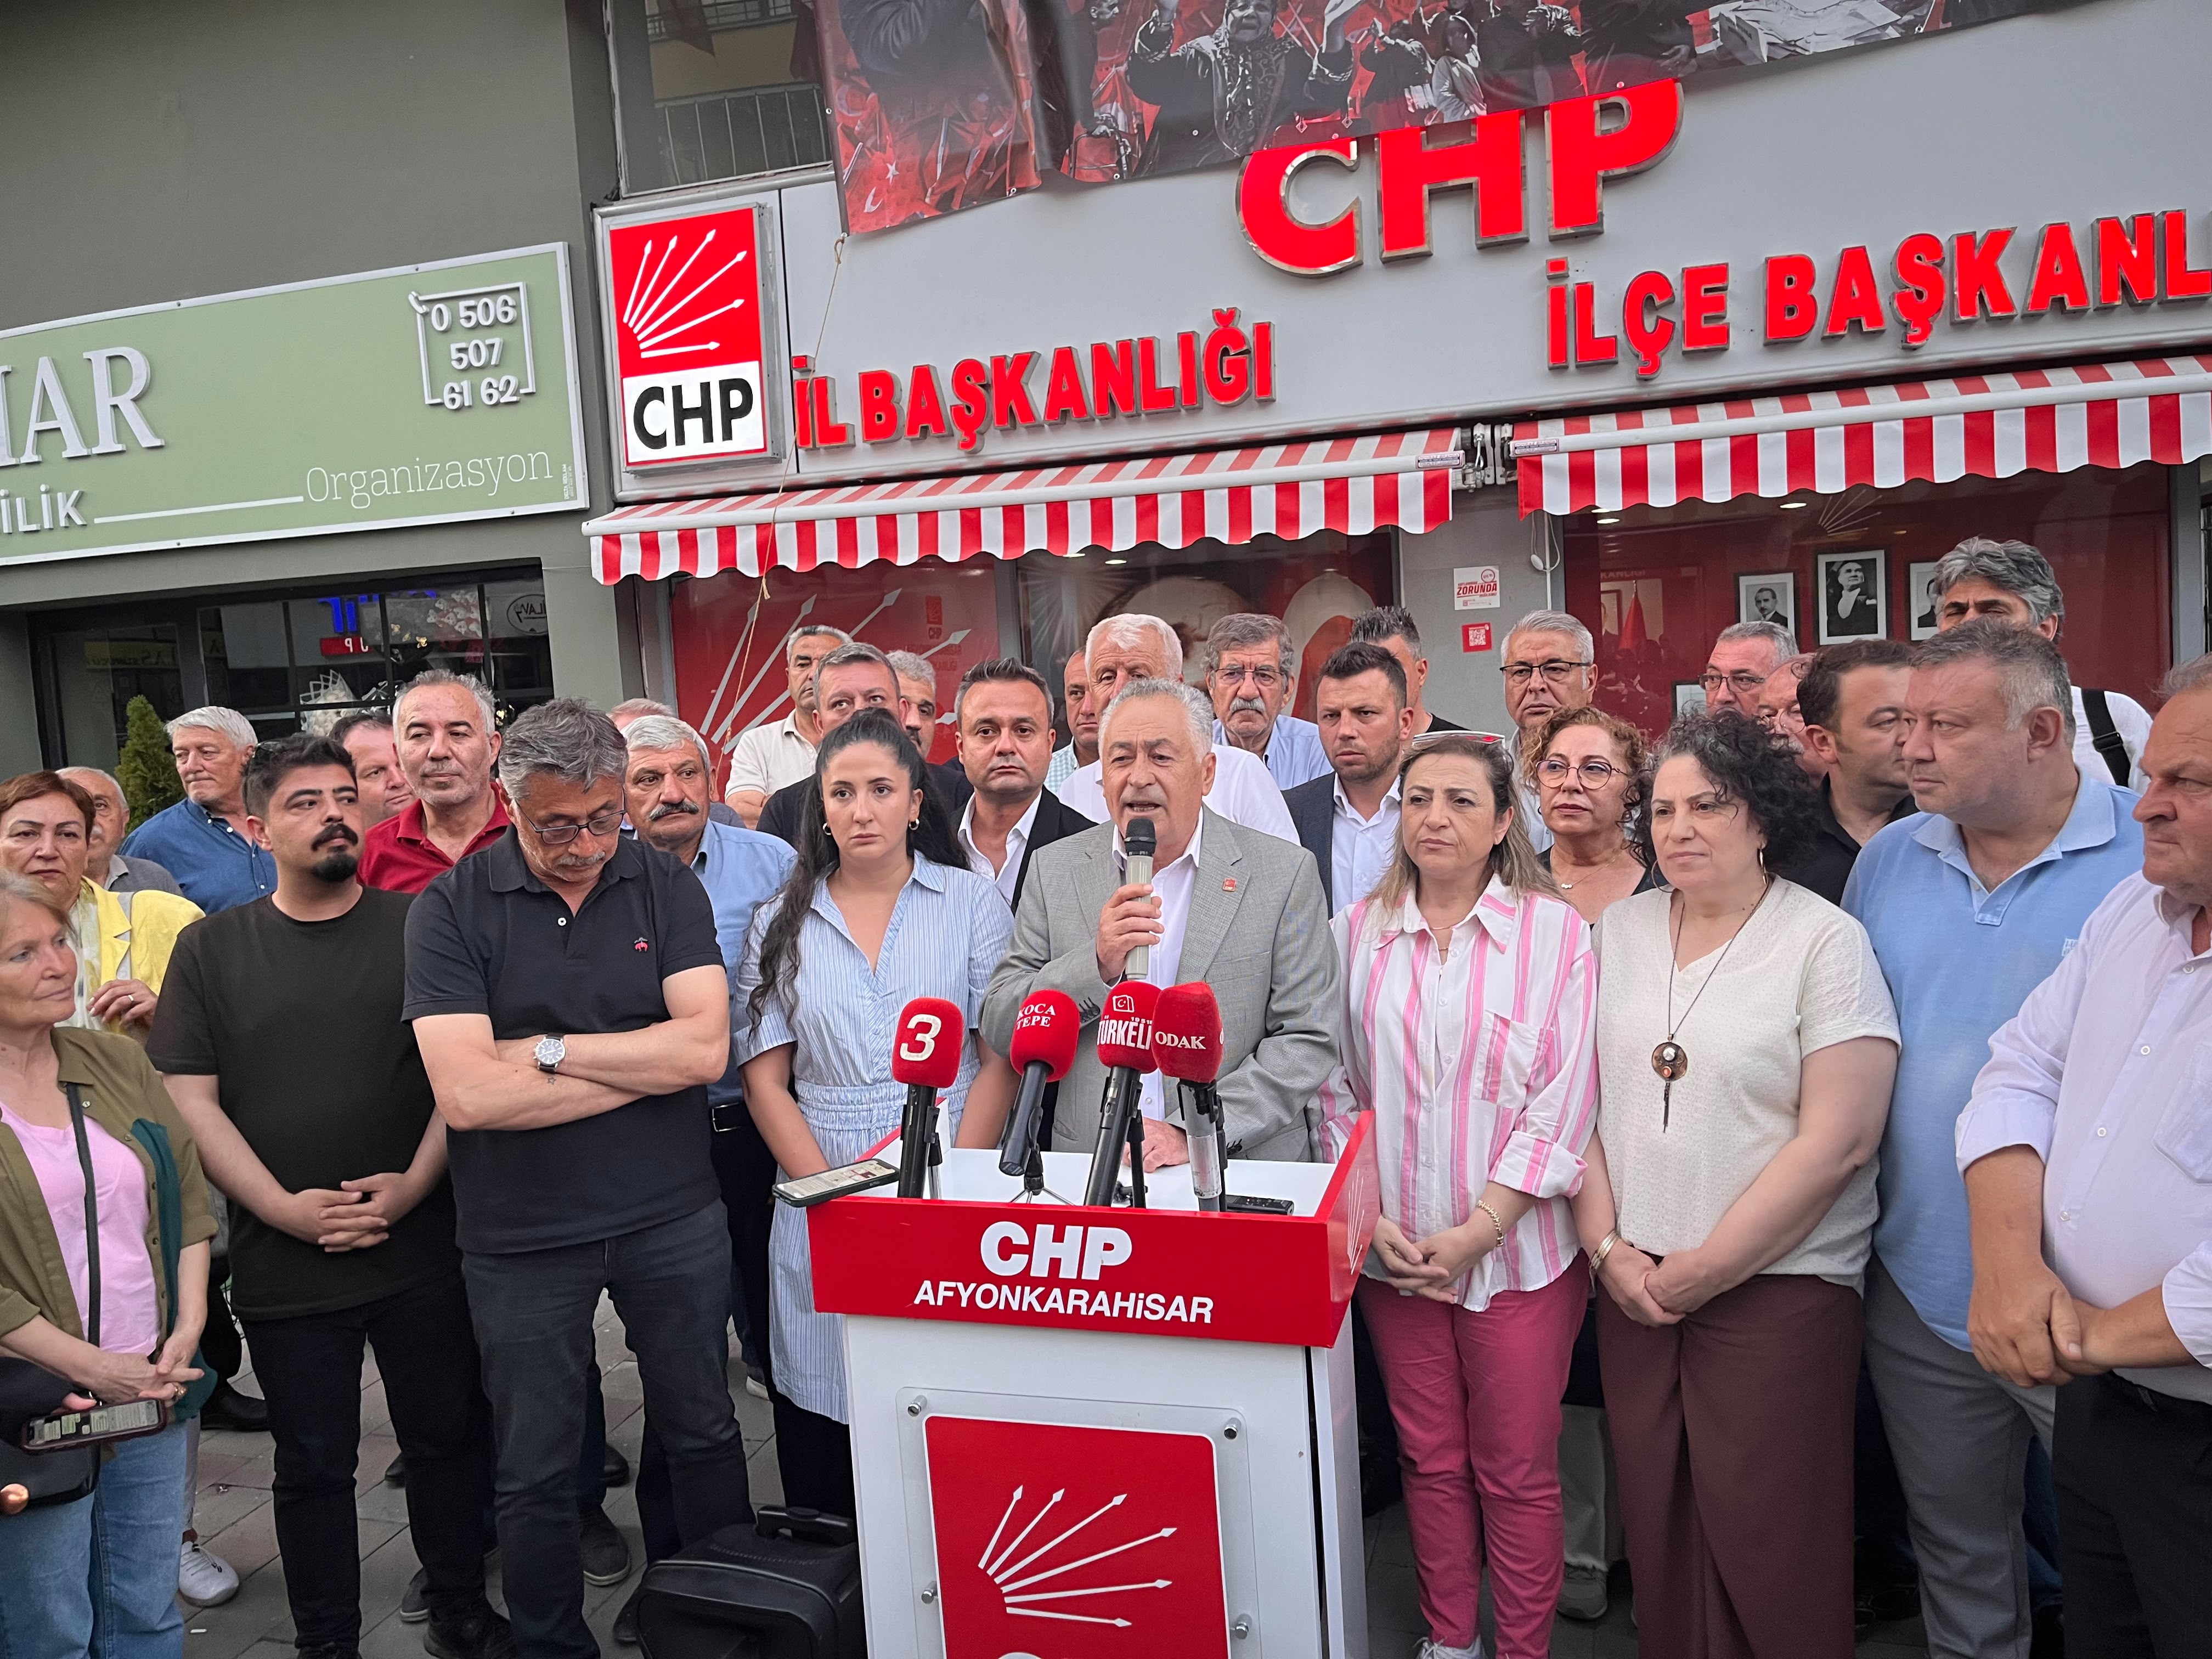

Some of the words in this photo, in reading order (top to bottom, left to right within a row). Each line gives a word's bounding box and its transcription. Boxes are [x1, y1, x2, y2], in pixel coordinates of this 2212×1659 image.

[1235, 78, 1685, 278] CHP
[1545, 257, 1730, 380] İLÇE
[1763, 208, 2212, 349] BAŞKANL
[431, 303, 452, 331] 0
[458, 295, 517, 329] 506
[450, 337, 503, 370] 507
[443, 380, 472, 410] 61
[480, 375, 521, 405] 62
[792, 355, 856, 451] İL
[858, 307, 1276, 454] BAŞKANLIĞI
[633, 377, 754, 450] CHP
[307, 450, 553, 509] Organizasyon
[1457, 583, 1497, 596] ZORUNDA
[1017, 1003, 1056, 1020] KOCA
[1017, 1015, 1051, 1030] TEPE
[900, 1014, 941, 1061] 3
[1097, 1015, 1152, 1050] TÜRKELİ
[1155, 1031, 1206, 1049] ODAK
[980, 1221, 1132, 1280] CHP
